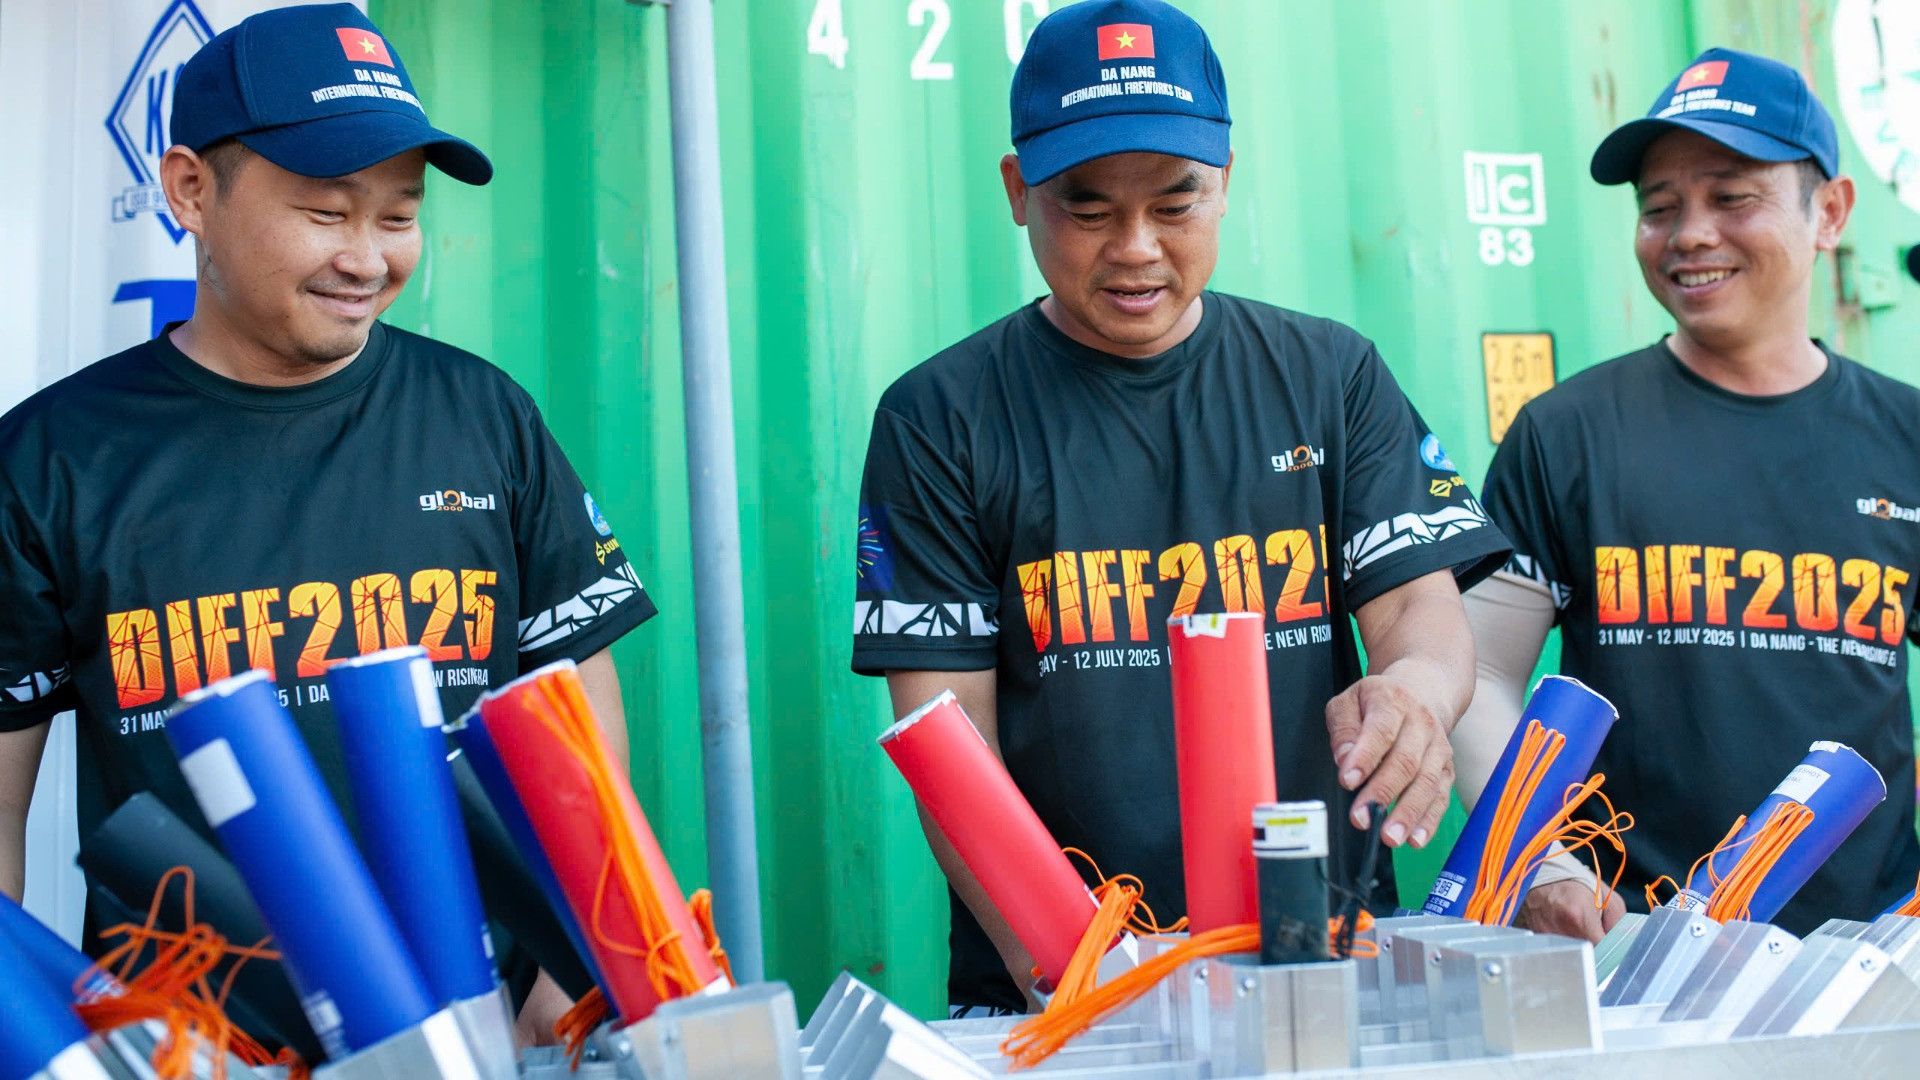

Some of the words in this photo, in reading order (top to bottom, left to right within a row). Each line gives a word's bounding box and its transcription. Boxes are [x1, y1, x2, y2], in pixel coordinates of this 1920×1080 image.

[353, 68, 373, 82] DA
[371, 70, 402, 87] NANG
[1101, 67, 1118, 81] DA
[1120, 65, 1155, 80] NANG
[311, 83, 383, 103] INTERNATIONAL
[1061, 82, 1123, 108] INTERNATIONAL
[1124, 81, 1174, 97] FIREWORKS
[1173, 85, 1193, 103] TEAM
[145, 63, 186, 158] K
[1479, 226, 1535, 267] 83
[419, 489, 496, 512] global
[1017, 524, 1332, 653] DIFF202
[1595, 544, 1910, 647] DIFF2025
[105, 568, 498, 709] DIFF2025
[1074, 651, 1090, 669] 12
[1094, 650, 1125, 668] JULY
[1128, 648, 1161, 667] 2025
[1275, 627, 1308, 649] NEW
[1599, 630, 1613, 646] 31
[1616, 629, 1644, 645] MAY
[1656, 629, 1671, 646] 12
[1673, 628, 1701, 645] JULY
[1702, 629, 1735, 647] 2025
[1750, 633, 1768, 649] DA
[1769, 634, 1806, 652] NANG
[1816, 636, 1839, 655] THE
[308, 684, 330, 703] DA
[119, 715, 137, 735] 31
